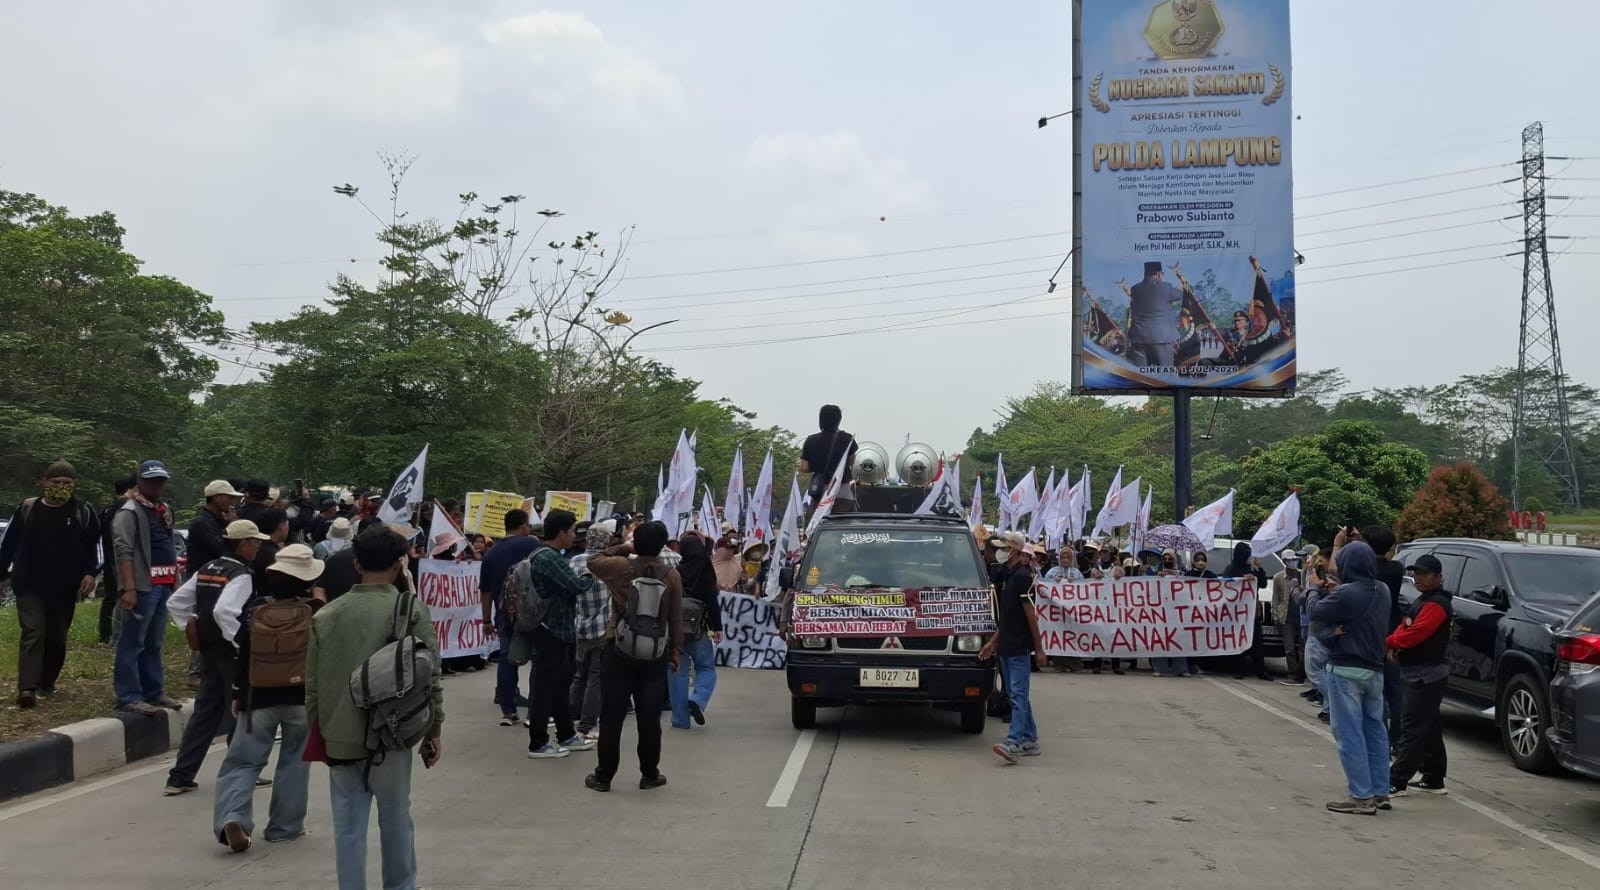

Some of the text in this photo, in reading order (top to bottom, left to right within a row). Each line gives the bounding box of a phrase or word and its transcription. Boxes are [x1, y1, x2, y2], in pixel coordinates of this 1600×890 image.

[1173, 65, 1235, 74] KEHORMATAN
[1108, 73, 1265, 100] NUGRAHA SAKANTI
[1130, 109, 1241, 122] APRESIASI TERTINGGI
[1148, 122, 1222, 134] Diberikan Kepada
[1092, 136, 1281, 172] POLDA LAMPUNG
[1166, 174, 1182, 182] Kerja
[1198, 188, 1234, 196] Masyarakat
[1136, 211, 1234, 222] Prabowo Subianto
[1134, 243, 1149, 252] Irjen
[1162, 242, 1176, 250] Helfi
[1226, 240, 1240, 248] M.H.
[1140, 366, 1178, 375] CIKEAS,
[420, 572, 482, 608] KEMBALIKA
[1204, 579, 1256, 602] BSA
[797, 594, 904, 605] SPL LAMPUNG TIMUR
[720, 596, 782, 630] MPUN
[810, 608, 914, 617] BERSATU KITA KUAT
[954, 614, 993, 622] PEREMPUA
[1036, 604, 1248, 624] KEMBALIKAN TANAH
[795, 622, 905, 633] BERSAMA KITA HEBAT
[972, 623, 996, 632] MELAW
[1111, 626, 1182, 654] ANAK
[1183, 624, 1248, 651] TUHA
[862, 670, 916, 681] A 8027 ZA
